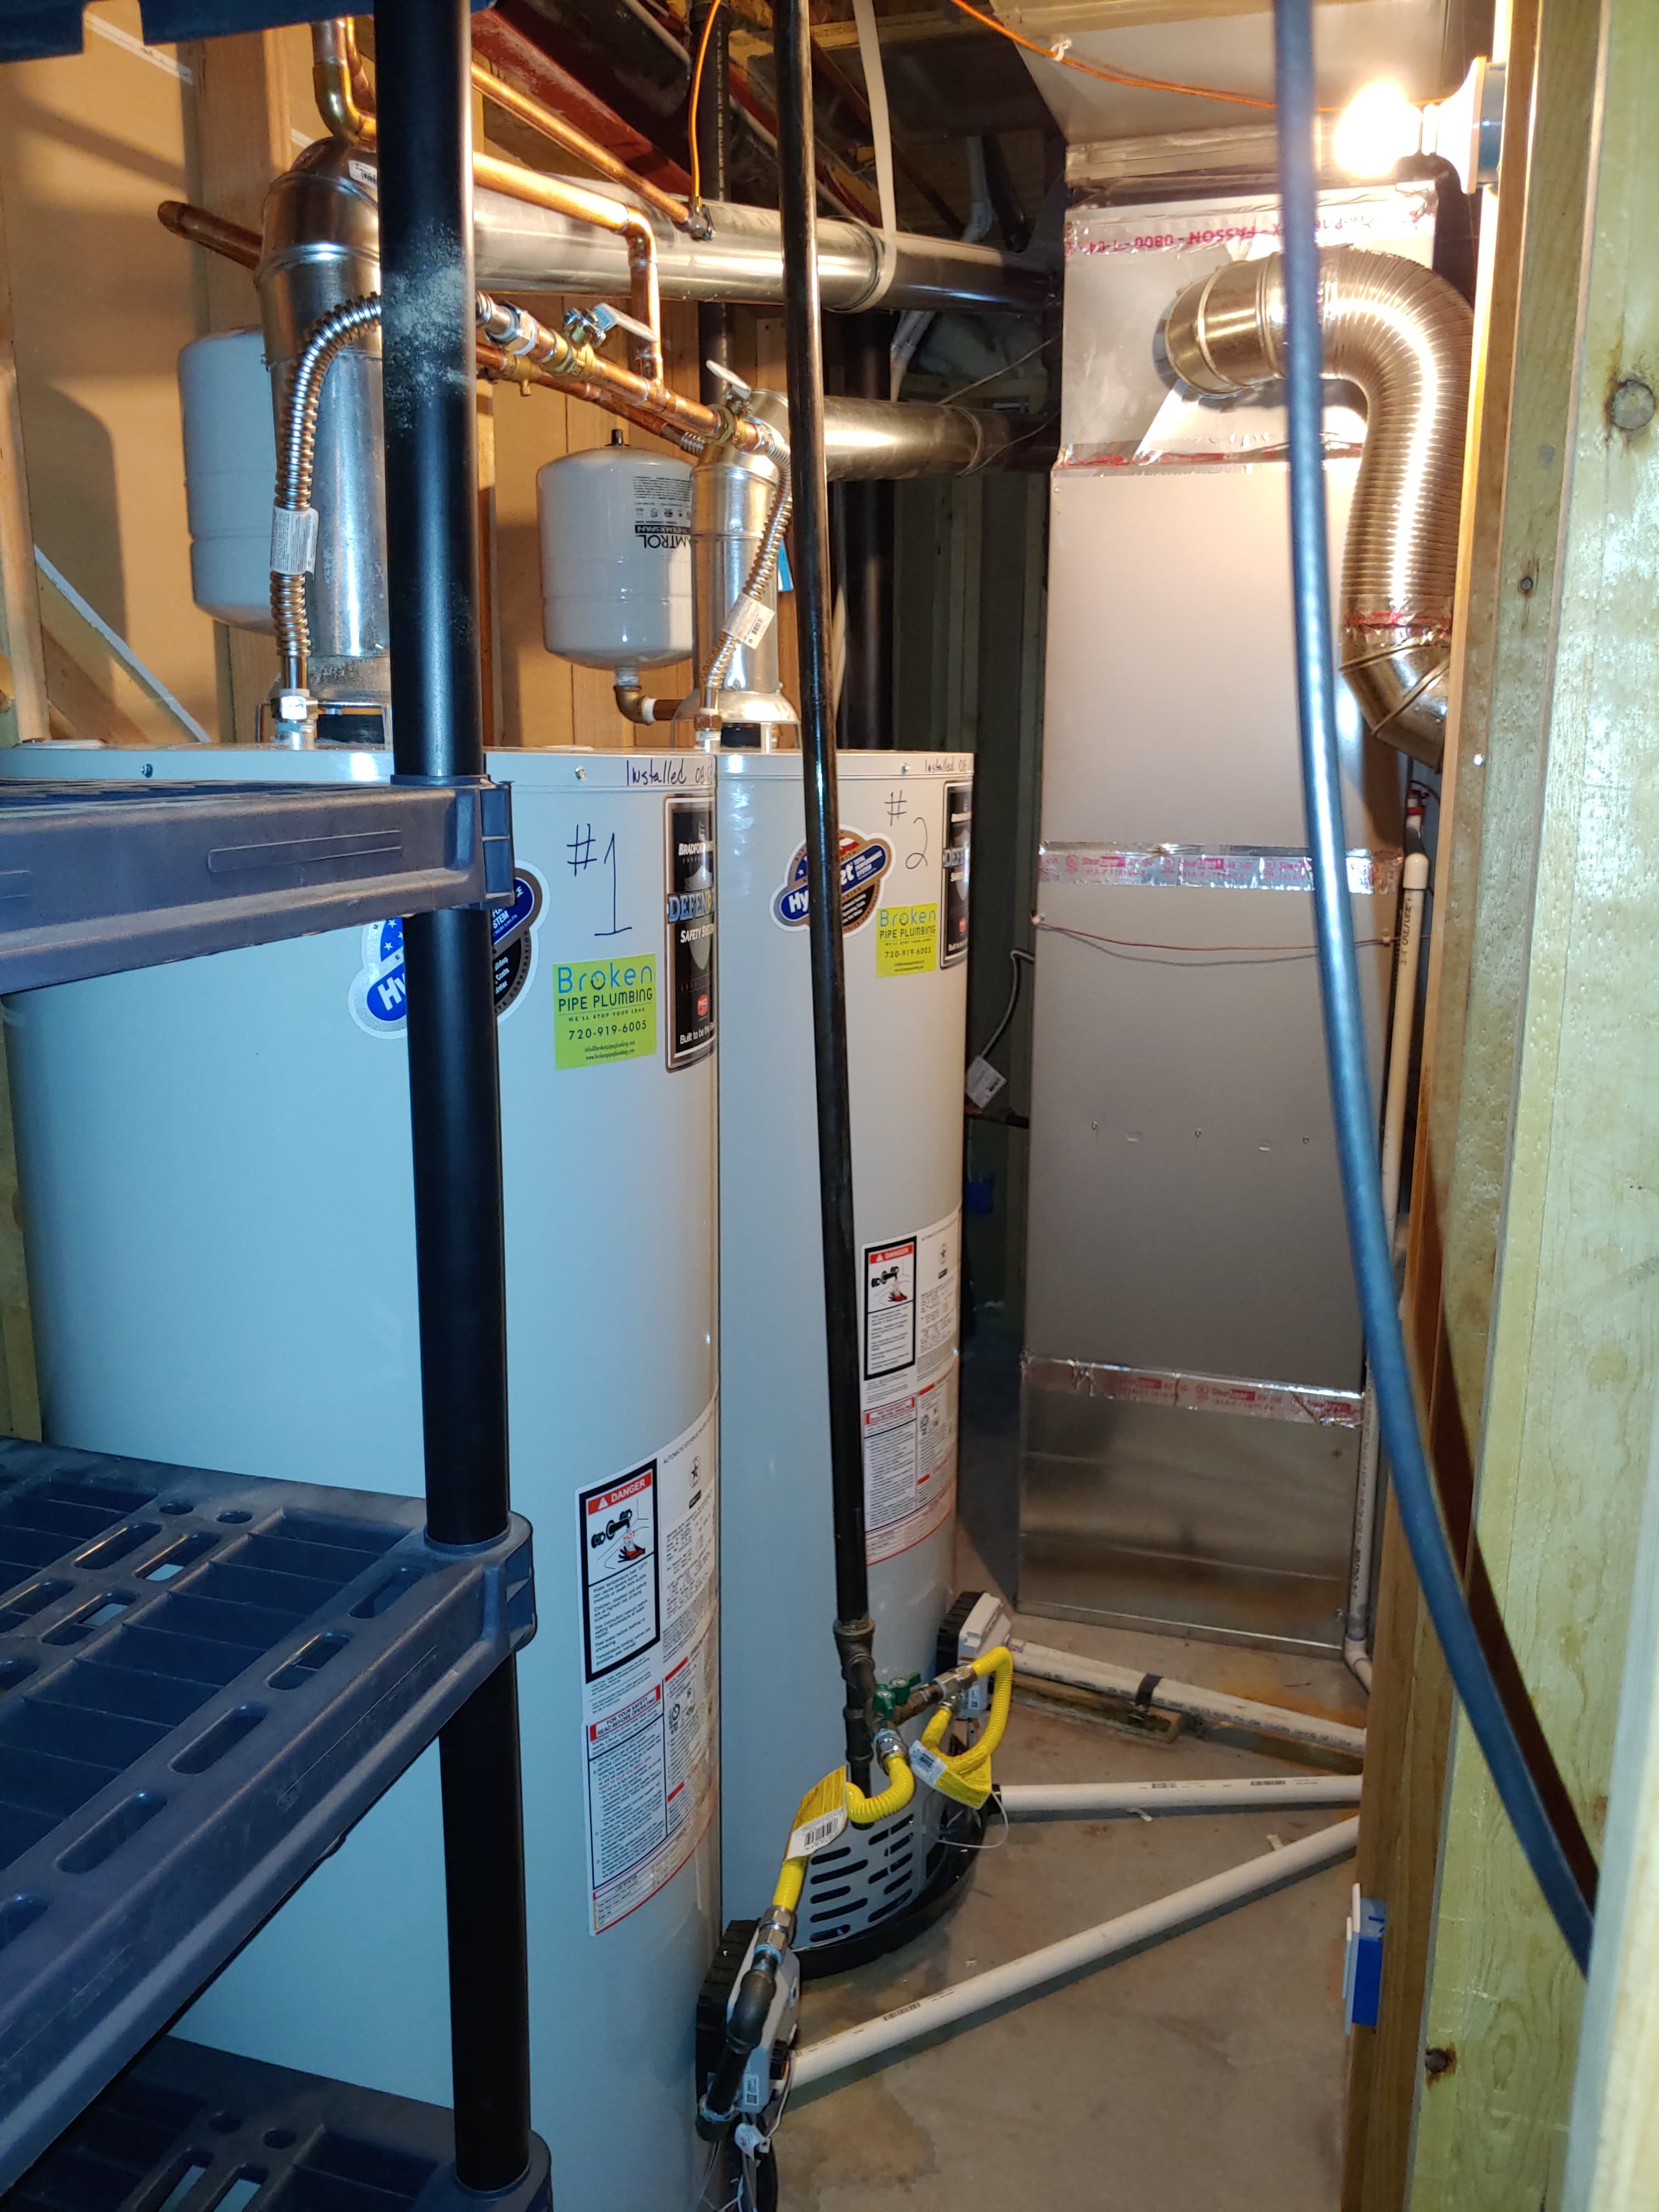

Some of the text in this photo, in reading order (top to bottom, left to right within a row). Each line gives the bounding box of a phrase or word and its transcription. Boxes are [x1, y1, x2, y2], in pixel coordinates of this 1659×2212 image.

[1134, 234, 1174, 250] 0800
[1187, 226, 1256, 245] FASSON
[635, 535, 690, 549] MTROL
[627, 758, 687, 787] Installed
[492, 910, 510, 929] STEM
[880, 907, 936, 928] Broken
[680, 928, 701, 944] SAFETY
[879, 925, 936, 940] PIPE PLUMBING
[557, 962, 653, 994] Broken
[558, 987, 653, 1012] PIPE PLUMBING
[568, 1020, 647, 1040] 720-919-6005
[680, 1032, 692, 1045] Built
[693, 1030, 698, 1040] to
[698, 1028, 704, 1037] be
[611, 1478, 646, 1503] DANGER
[623, 1531, 635, 1542] HOT
[606, 1697, 648, 1725] FOR YOUR SAFETY
[612, 1713, 631, 1728] BEFORE
